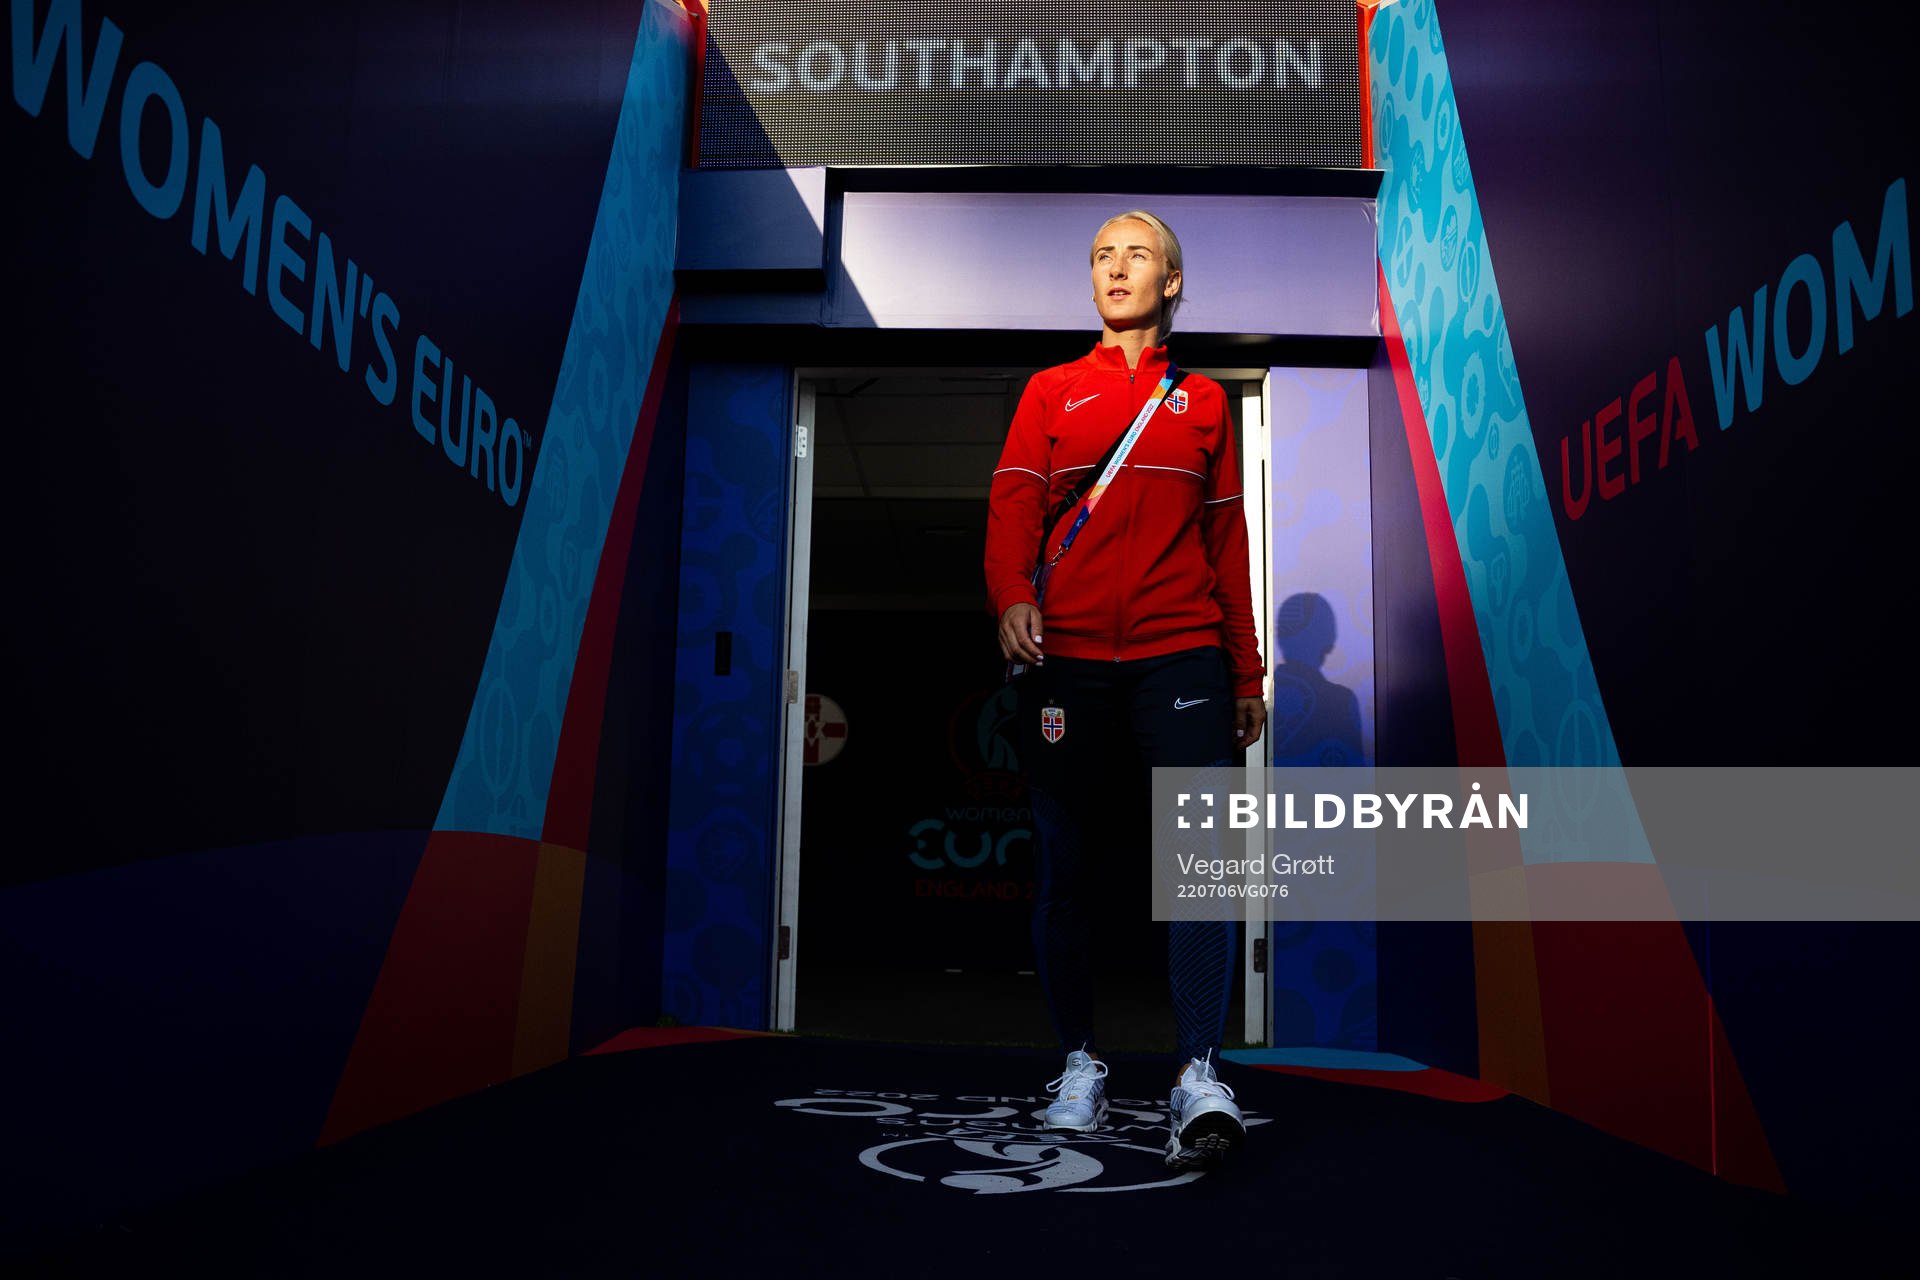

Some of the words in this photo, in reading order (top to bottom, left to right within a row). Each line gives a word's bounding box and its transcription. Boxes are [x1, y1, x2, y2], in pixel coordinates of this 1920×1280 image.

[750, 37, 1323, 93] SOUTHAMPTON
[9, 0, 401, 407] WOMEN'S
[1560, 354, 1701, 521] UEFA
[1704, 176, 1915, 432] WOM
[914, 878, 1019, 897] ENGLAND
